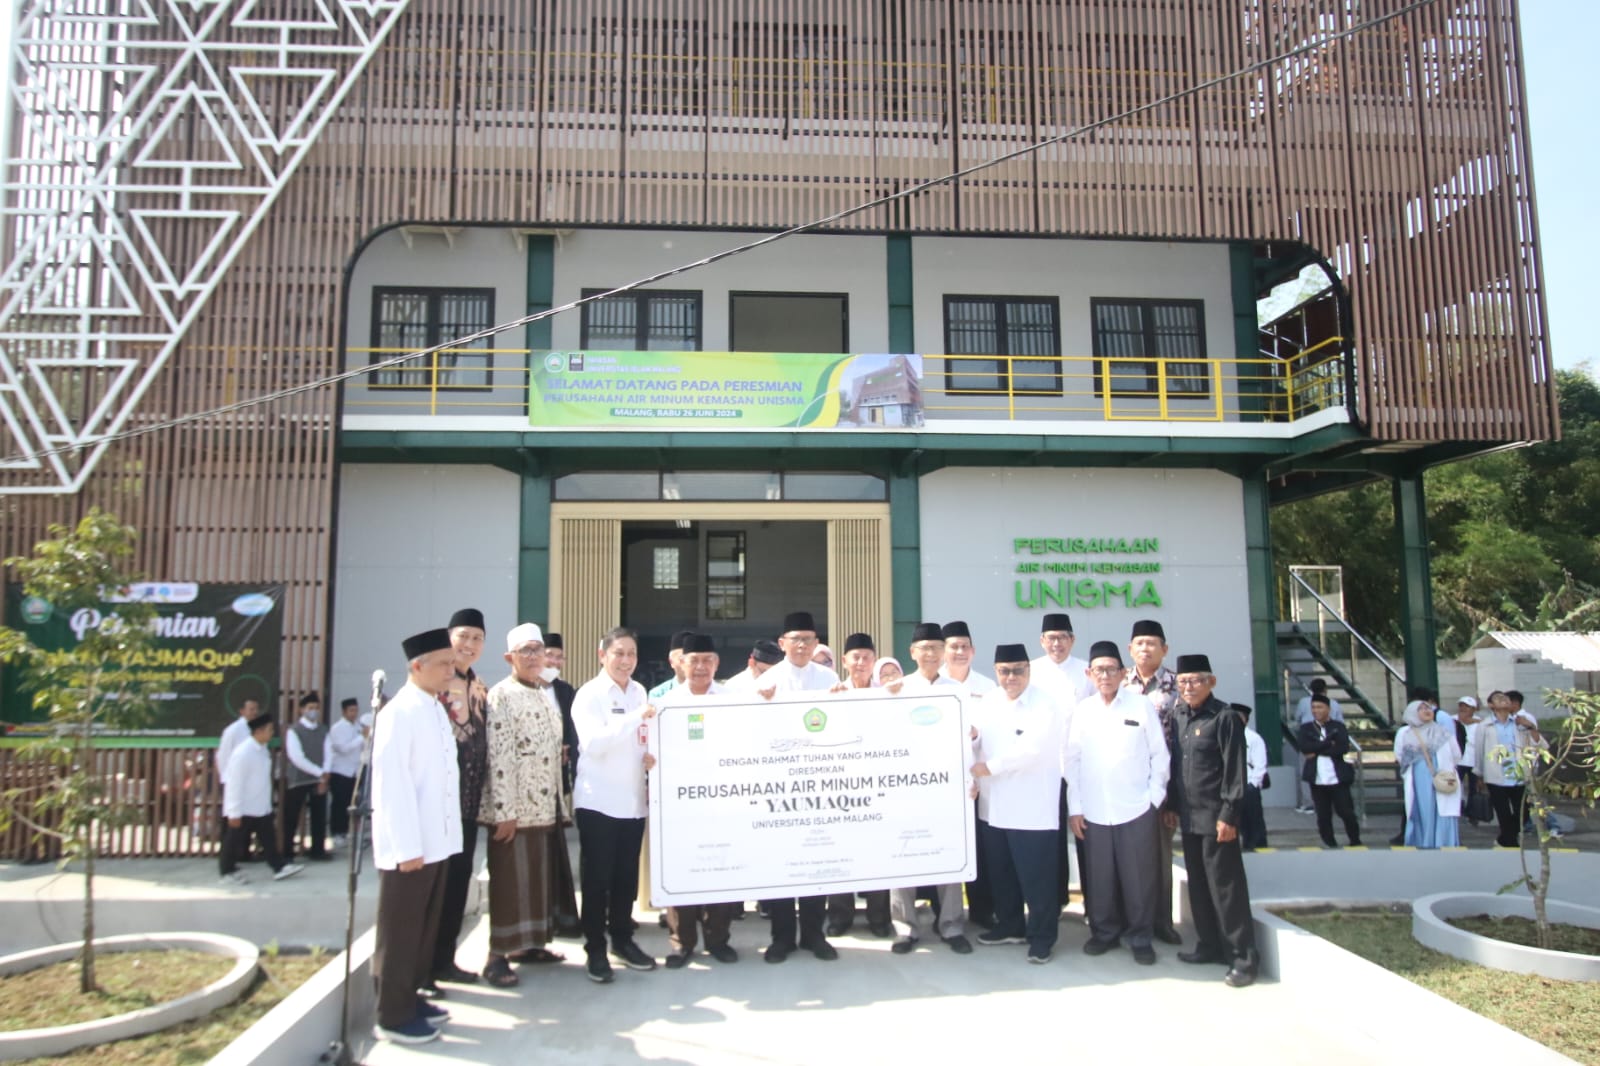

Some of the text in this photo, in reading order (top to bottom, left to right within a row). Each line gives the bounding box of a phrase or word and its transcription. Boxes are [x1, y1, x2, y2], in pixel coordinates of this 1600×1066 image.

[546, 379, 803, 392] SELAMAT DATANG PADA PERESMIAN
[543, 393, 804, 406] PERUSAHAAN AIR MINUM KEMASAN UNISMA
[657, 409, 681, 417] RABU
[683, 409, 693, 417] 26
[695, 409, 714, 417] JUNI
[716, 409, 737, 417] 2024
[1014, 538, 1159, 555] PERUSAHAAN
[1016, 562, 1161, 574] AIR MINUM KEMASAN
[1015, 578, 1163, 609] UNISMA
[719, 749, 910, 767] DENGAN RAHMAT TUHAN YANG MAHA ESA
[788, 765, 845, 776] DIRESMIKAN
[677, 771, 949, 799] PERUSAHAAN AIR MINUM KEMASAN
[752, 813, 883, 829] UNIVERSITAS ISLAM MALANG
